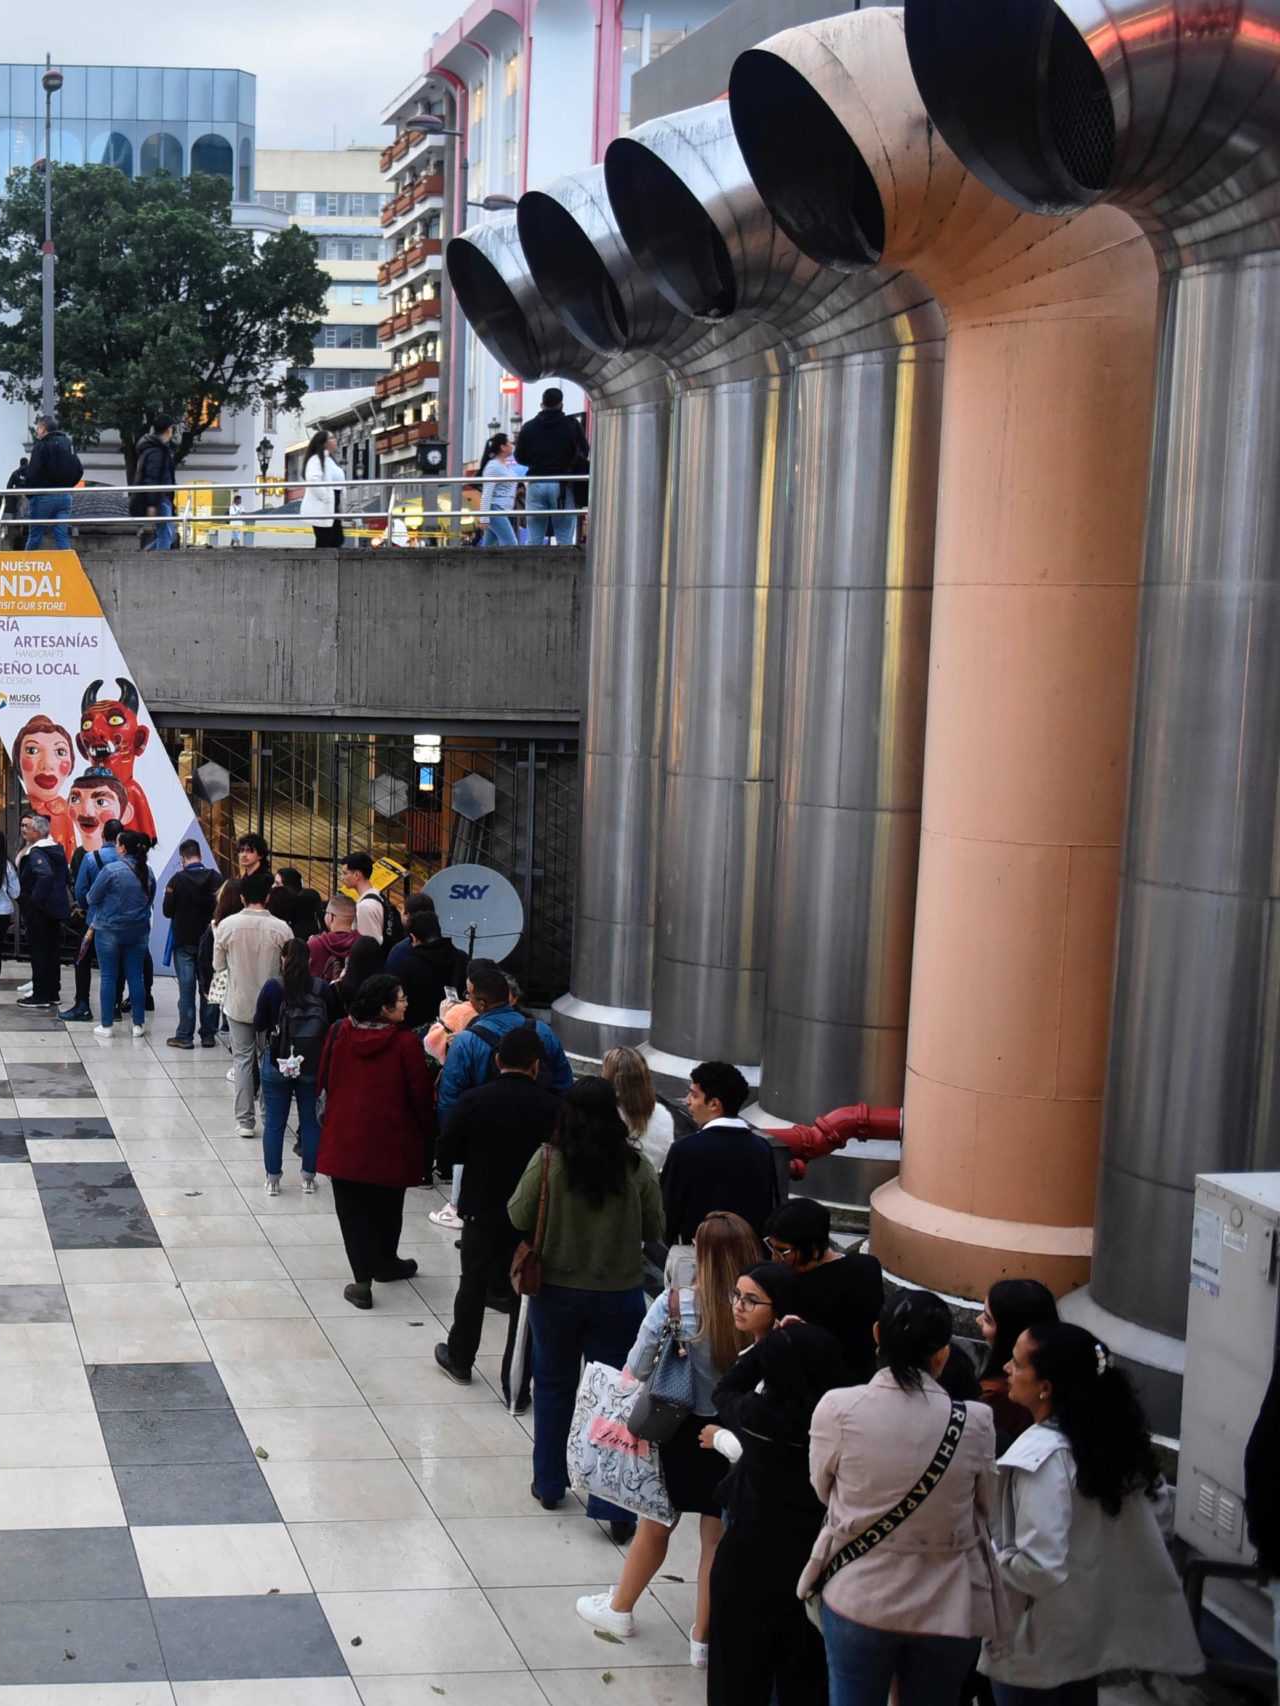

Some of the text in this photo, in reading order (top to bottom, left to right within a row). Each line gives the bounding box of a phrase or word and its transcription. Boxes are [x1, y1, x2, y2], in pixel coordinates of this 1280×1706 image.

[1, 561, 53, 572] NUESTRA
[17, 601, 36, 611] OUR
[37, 601, 67, 611] STORE!
[13, 632, 98, 648] ARTESANÍAS
[15, 650, 64, 658] HANDICRAFTS
[36, 663, 80, 676] LOCAL
[6, 677, 32, 685] DESIGN
[9, 694, 41, 702] MUSEOS
[449, 884, 490, 900] SKY
